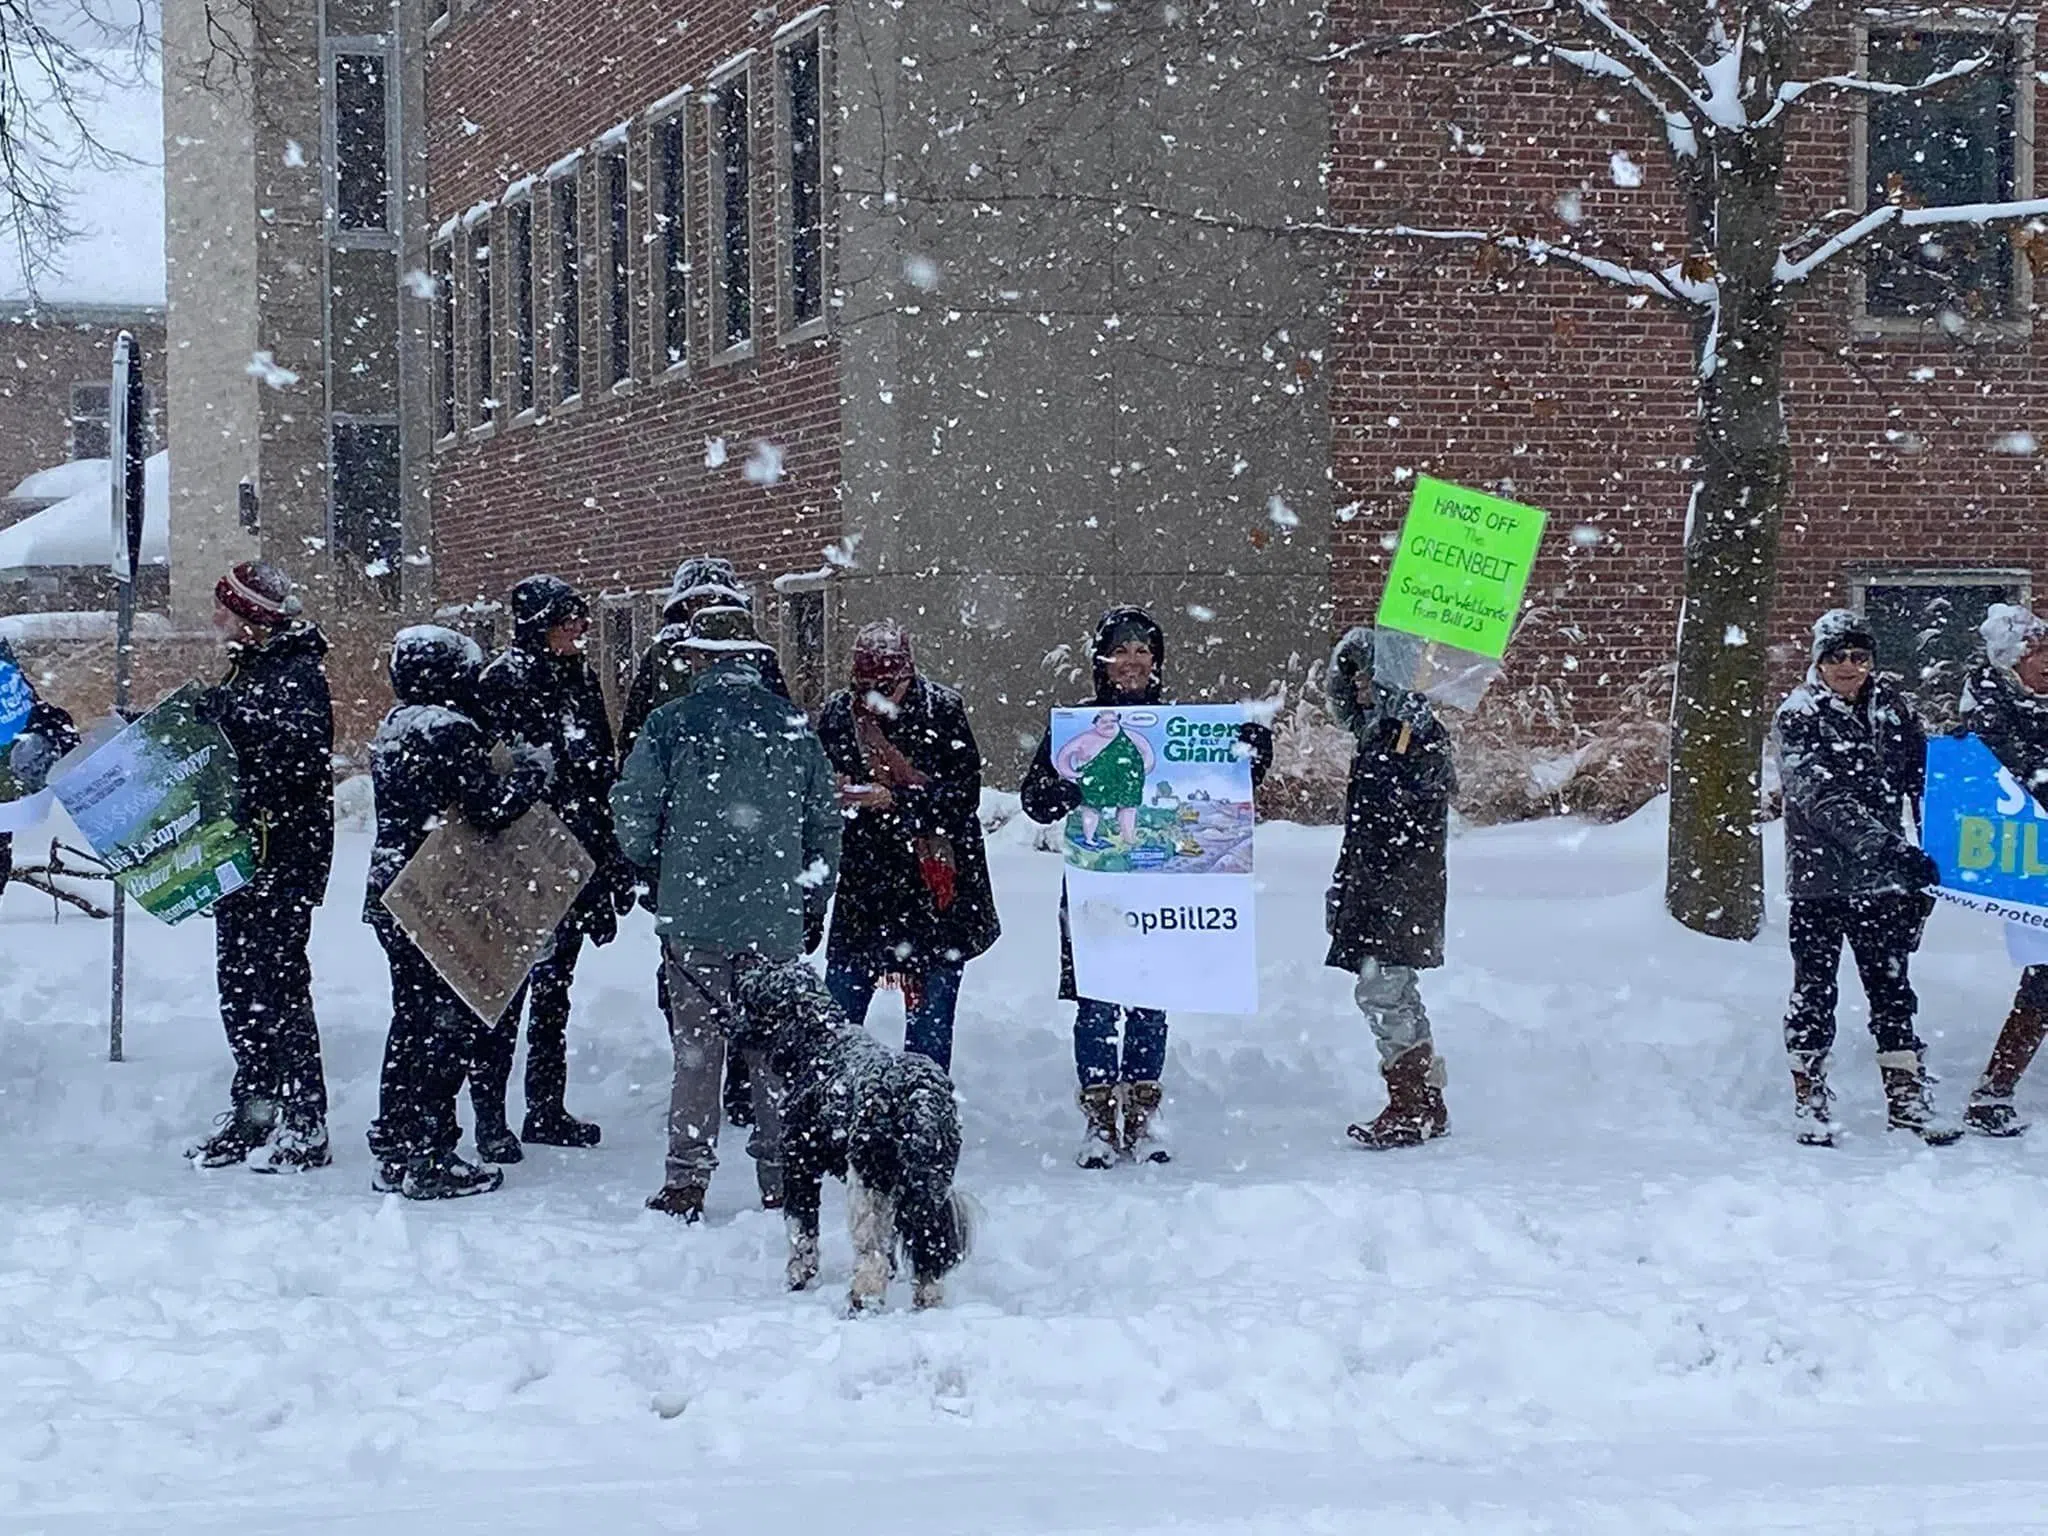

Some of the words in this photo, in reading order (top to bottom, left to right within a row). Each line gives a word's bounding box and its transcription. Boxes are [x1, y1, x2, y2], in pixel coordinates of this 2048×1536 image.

[1433, 496, 1482, 524] HANDS
[1485, 512, 1519, 535] OFF
[1464, 525, 1485, 547] The
[1411, 535, 1518, 583] GREENBELT
[1442, 608, 1463, 626] Bill
[1166, 716, 1242, 737] Green
[1163, 740, 1239, 762] Giant
[1113, 906, 1238, 935] opBill23
